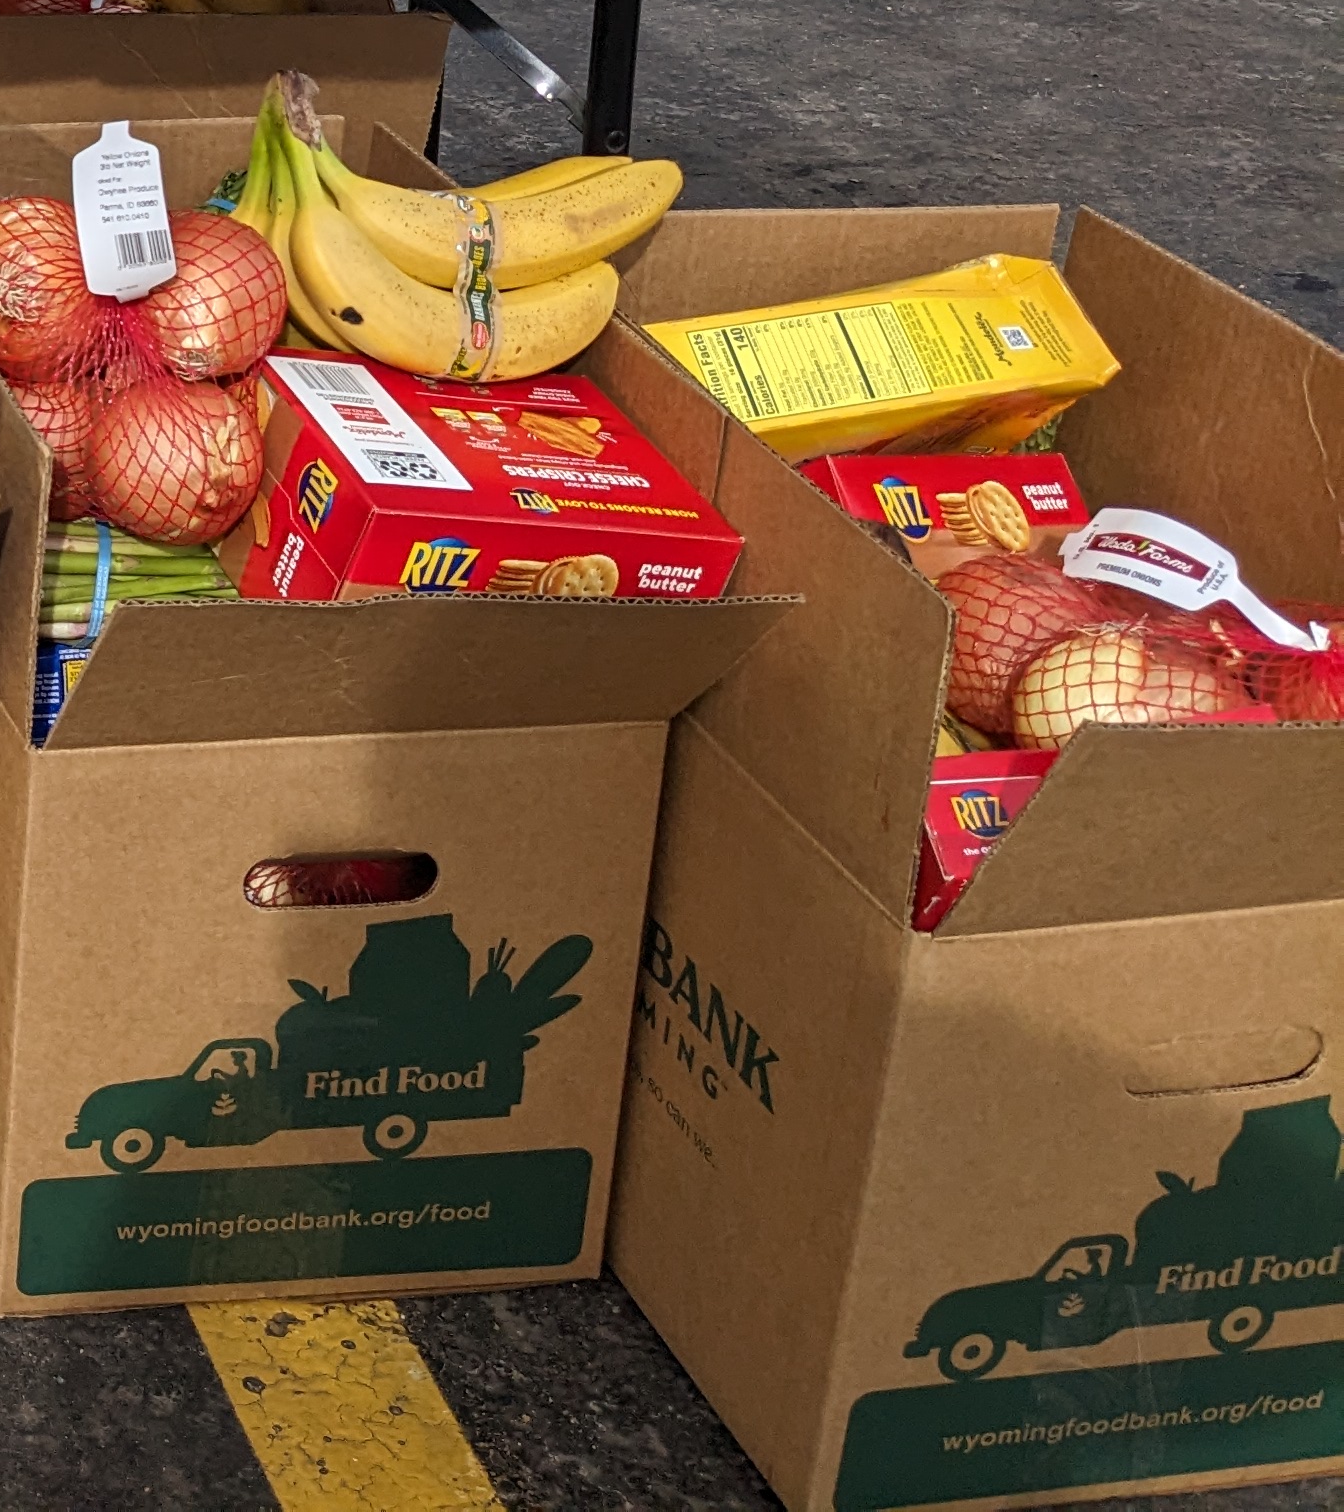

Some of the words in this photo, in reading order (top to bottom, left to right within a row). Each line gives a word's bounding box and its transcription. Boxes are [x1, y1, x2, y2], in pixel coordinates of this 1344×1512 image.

[692, 333, 713, 367] Facts
[729, 326, 749, 351] 140
[755, 374, 773, 415] Calories
[501, 464, 584, 482] CRISPERS
[585, 471, 651, 488] CHEESE
[298, 457, 339, 533] RITZ
[507, 489, 561, 515] RITZ
[554, 499, 588, 508] LOVE
[588, 501, 608, 510] TO
[873, 483, 934, 527] RITZ
[1022, 482, 1062, 499] peanut
[1030, 495, 1069, 512] butter
[608, 503, 662, 515] REASONS
[661, 507, 698, 518] MORE
[273, 532, 297, 588] butter
[279, 534, 305, 598] peanut
[399, 541, 481, 588] RITZ
[1098, 532, 1138, 558] Wada
[1138, 541, 1196, 574] Farms
[638, 563, 703, 580] peanut
[638, 576, 696, 594] butter
[1096, 559, 1131, 578] PREMIUM
[1130, 570, 1162, 587] ONIONS
[950, 796, 1009, 830] RITZ
[963, 847, 979, 856] the
[641, 918, 779, 1115] BANK
[638, 991, 718, 1099] MING
[305, 1067, 389, 1099] Find
[396, 1062, 487, 1095] Food
[647, 1077, 663, 1103] so
[667, 1100, 690, 1137] can
[116, 1202, 490, 1243] wyomingfoodbank.org/food
[1156, 1254, 1245, 1295] Find
[1250, 1247, 1343, 1285] Food
[943, 1390, 1324, 1452] wyomingfoodbank.org/food
